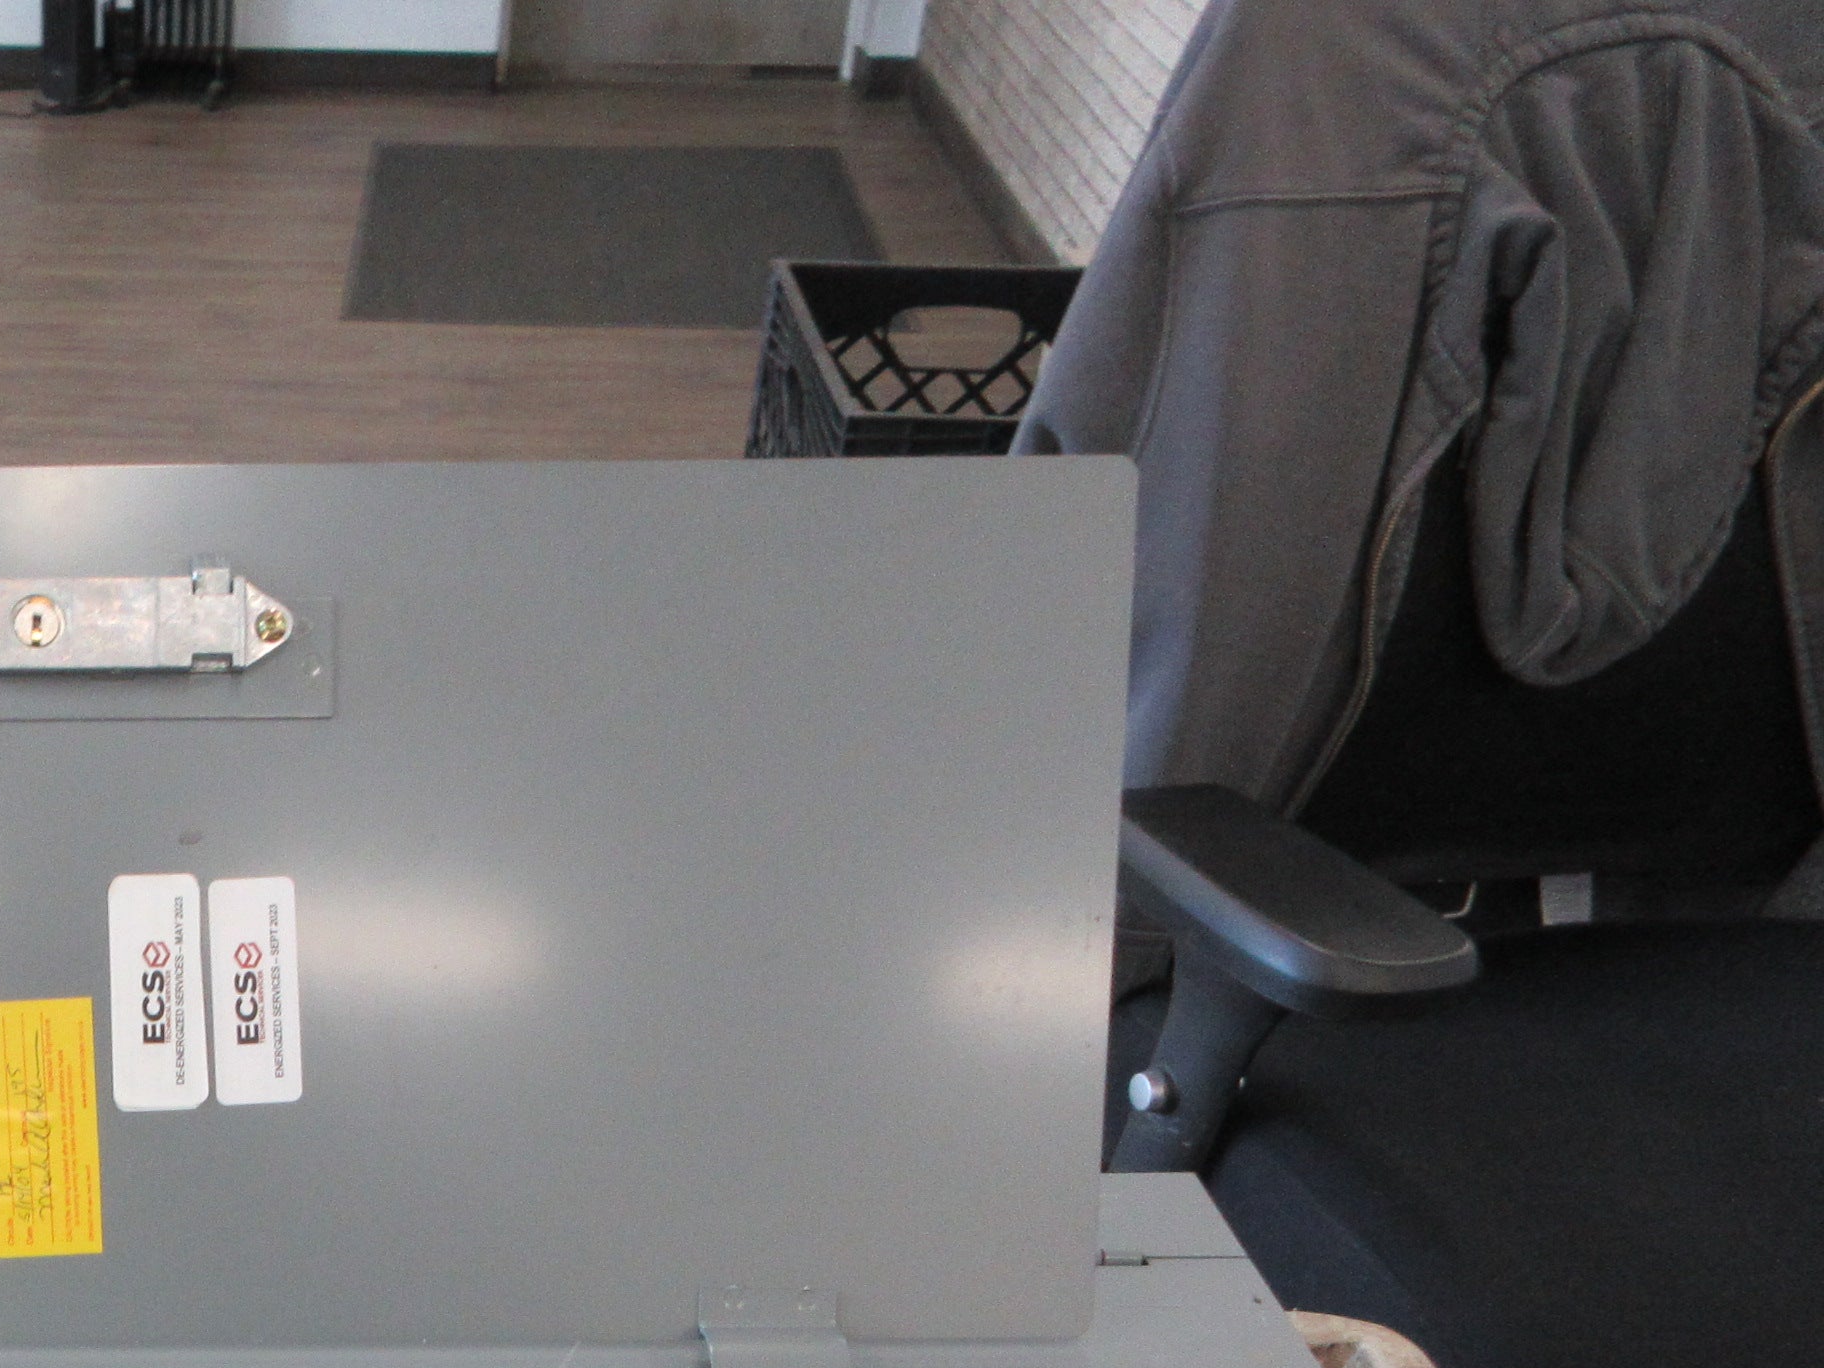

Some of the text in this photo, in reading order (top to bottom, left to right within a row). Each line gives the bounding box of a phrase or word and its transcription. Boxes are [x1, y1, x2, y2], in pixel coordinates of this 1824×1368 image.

[174, 922, 184, 944] MAY
[269, 929, 280, 955] SEPT
[141, 970, 166, 1044] ECS
[174, 954, 184, 1007] SERVICES
[235, 971, 260, 1045] ECS
[271, 966, 283, 1017] SERVICES
[174, 1009, 185, 1085] DE-ENERGIZED
[273, 1019, 285, 1078] ENERGIZED
